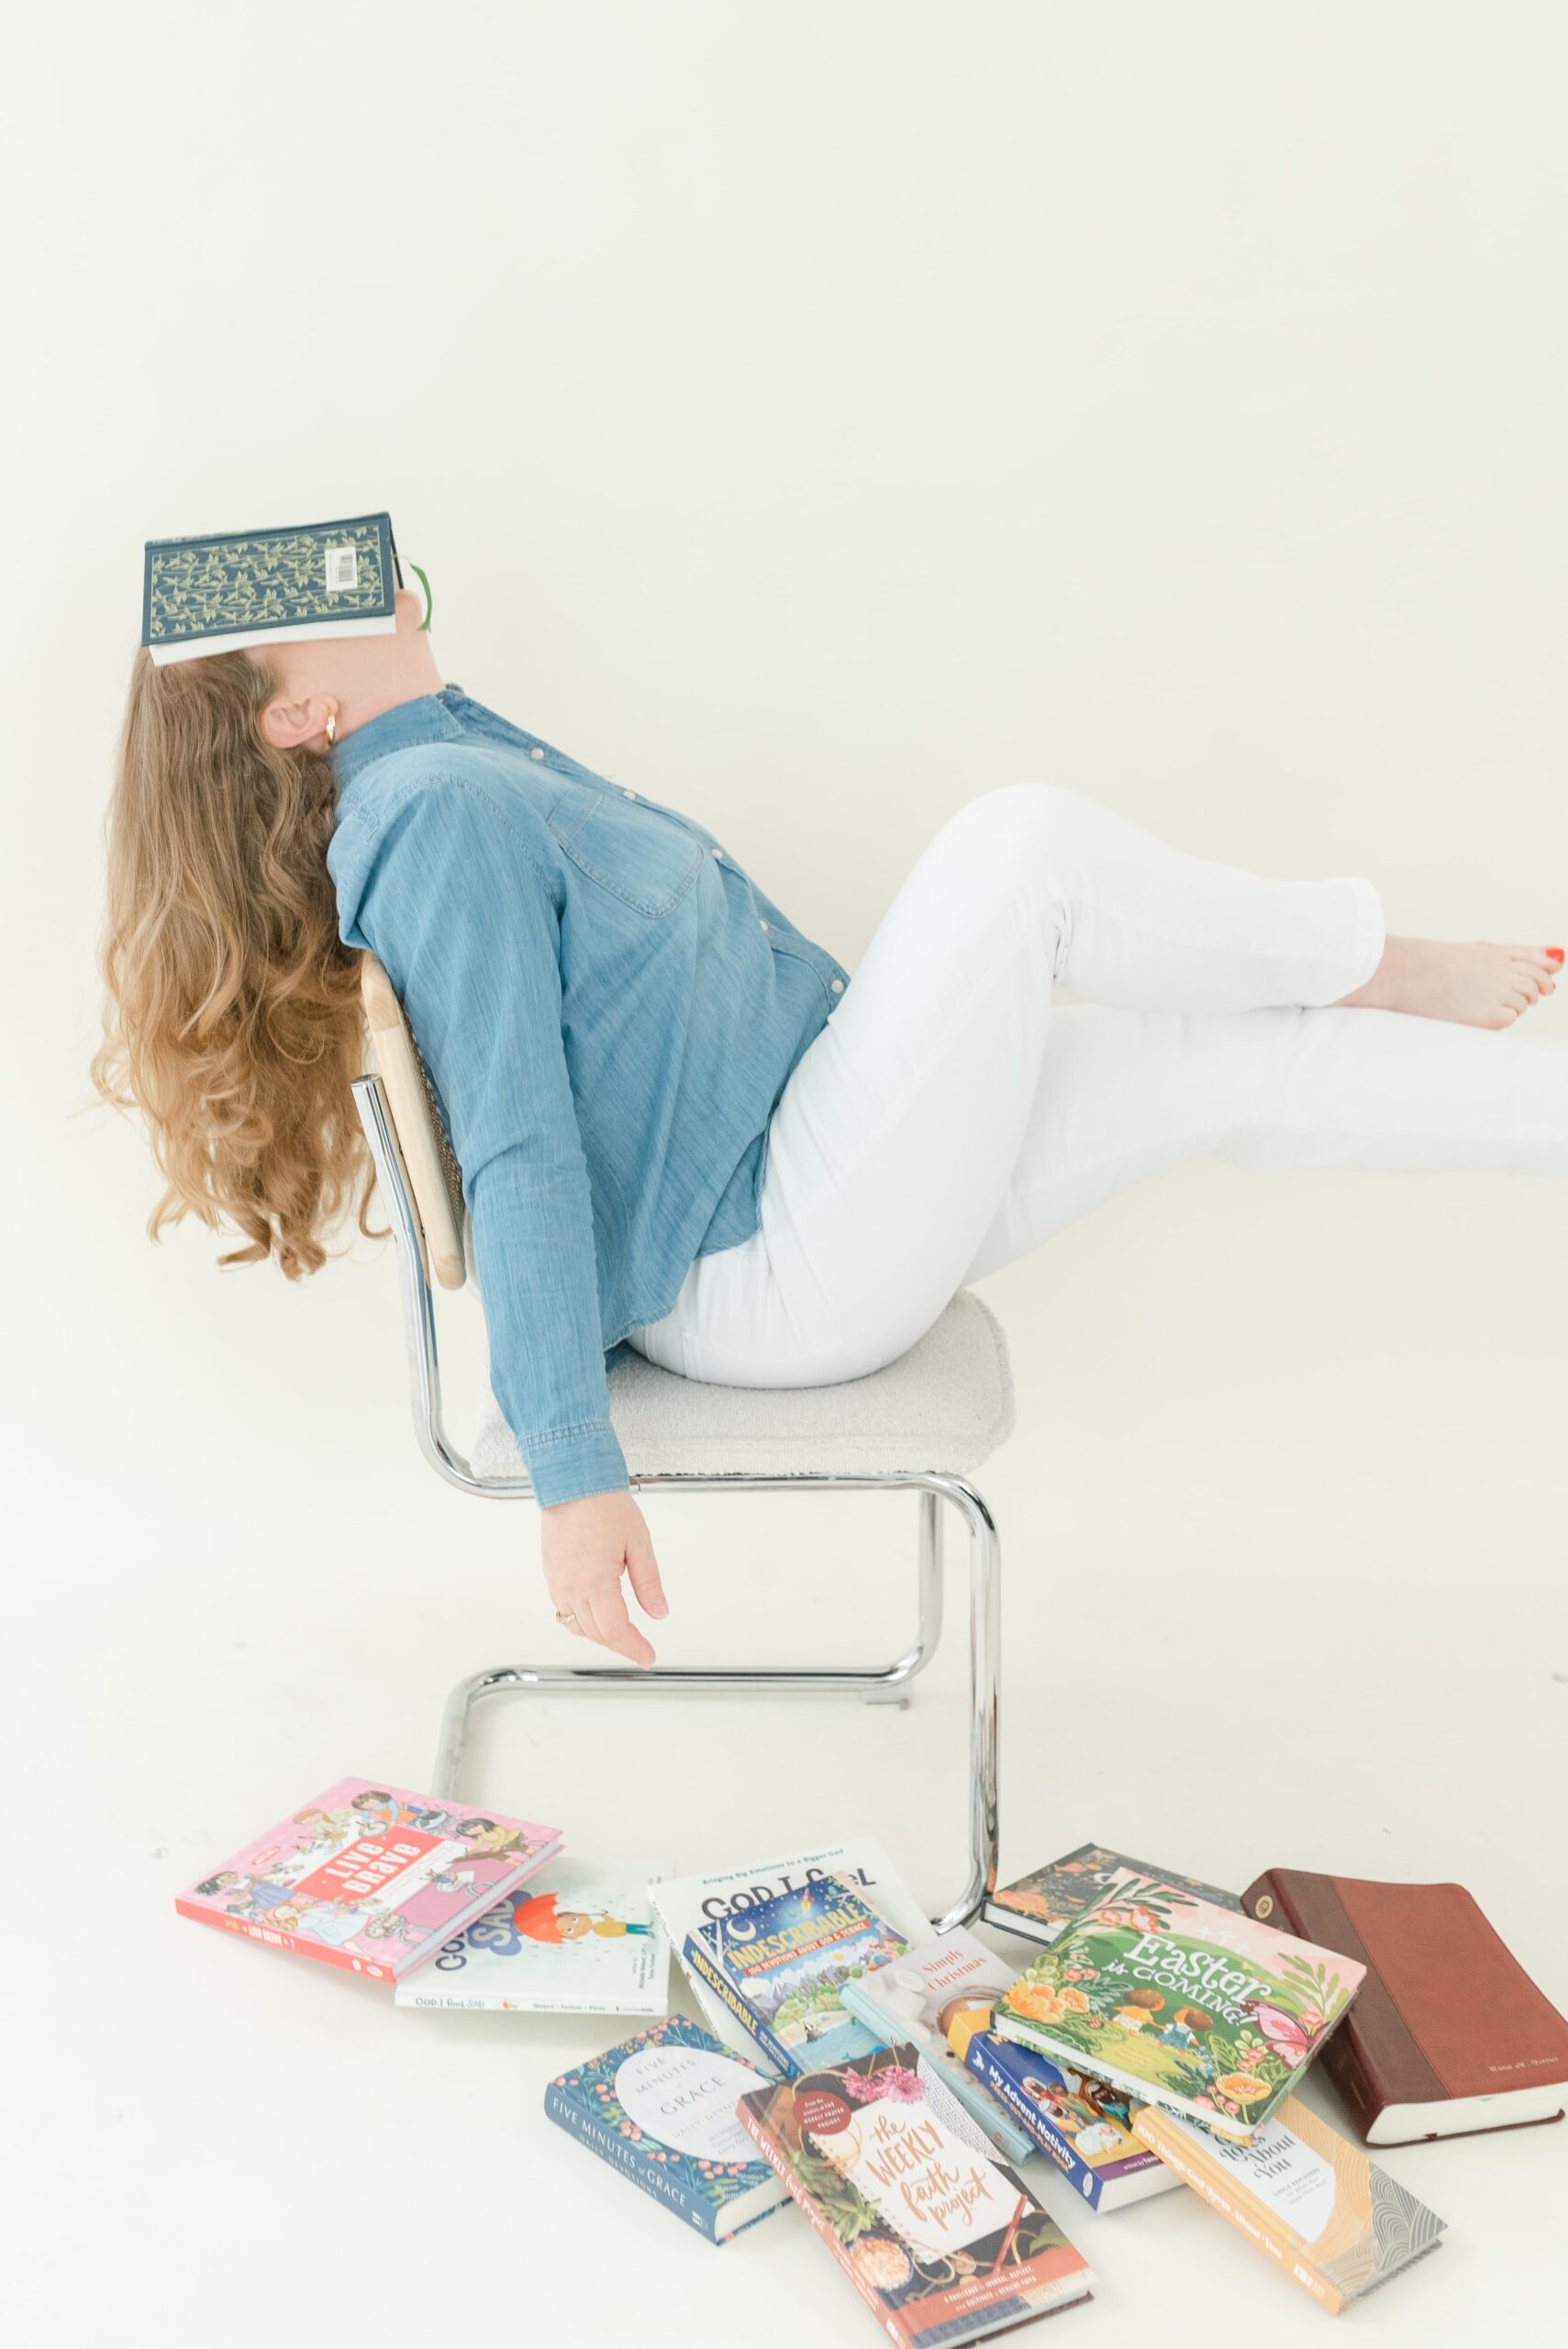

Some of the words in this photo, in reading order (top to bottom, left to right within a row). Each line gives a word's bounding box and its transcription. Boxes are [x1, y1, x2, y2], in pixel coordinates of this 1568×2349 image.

[703, 1875, 733, 1885] Bringing
[750, 1864, 784, 1875] Emotions
[803, 1854, 826, 1863] Bigger
[436, 1932, 467, 1970] GO
[727, 1904, 867, 1969] INDESCRIBABLE
[748, 1965, 762, 1975] 100
[763, 1950, 797, 1969] DEVOTIONS
[798, 1942, 818, 1954] ABOUT
[922, 1950, 964, 1973] Simply
[928, 1957, 987, 1990] Christmas
[1102, 1958, 1129, 1975] is
[1123, 1932, 1271, 2005] Easter
[692, 1951, 758, 2036] INDESCRIBABLE
[636, 2059, 696, 2094] MINUTES
[637, 2055, 667, 2076] FIVE
[661, 2076, 727, 2115] GRACE
[803, 2114, 823, 2124] WEEKLY
[870, 2114, 906, 2143] the
[989, 2065, 1004, 2087] My
[1004, 2084, 1037, 2124] Advent
[1037, 2120, 1076, 2169] Nativity
[552, 2098, 578, 2124] FIVE
[582, 2120, 636, 2168] MINUTES
[647, 2169, 686, 2207] GRACE
[580, 2134, 604, 2155] DAILY
[608, 2156, 657, 2198] DEVOTIONS
[746, 2117, 760, 2141] THE
[760, 2136, 786, 2177] WEEKLY
[865, 2120, 944, 2188] WEEKLY
[1249, 2134, 1296, 2167] About
[1253, 2158, 1292, 2178] You
[900, 2162, 960, 2222] faith
[928, 2166, 995, 2232] project
